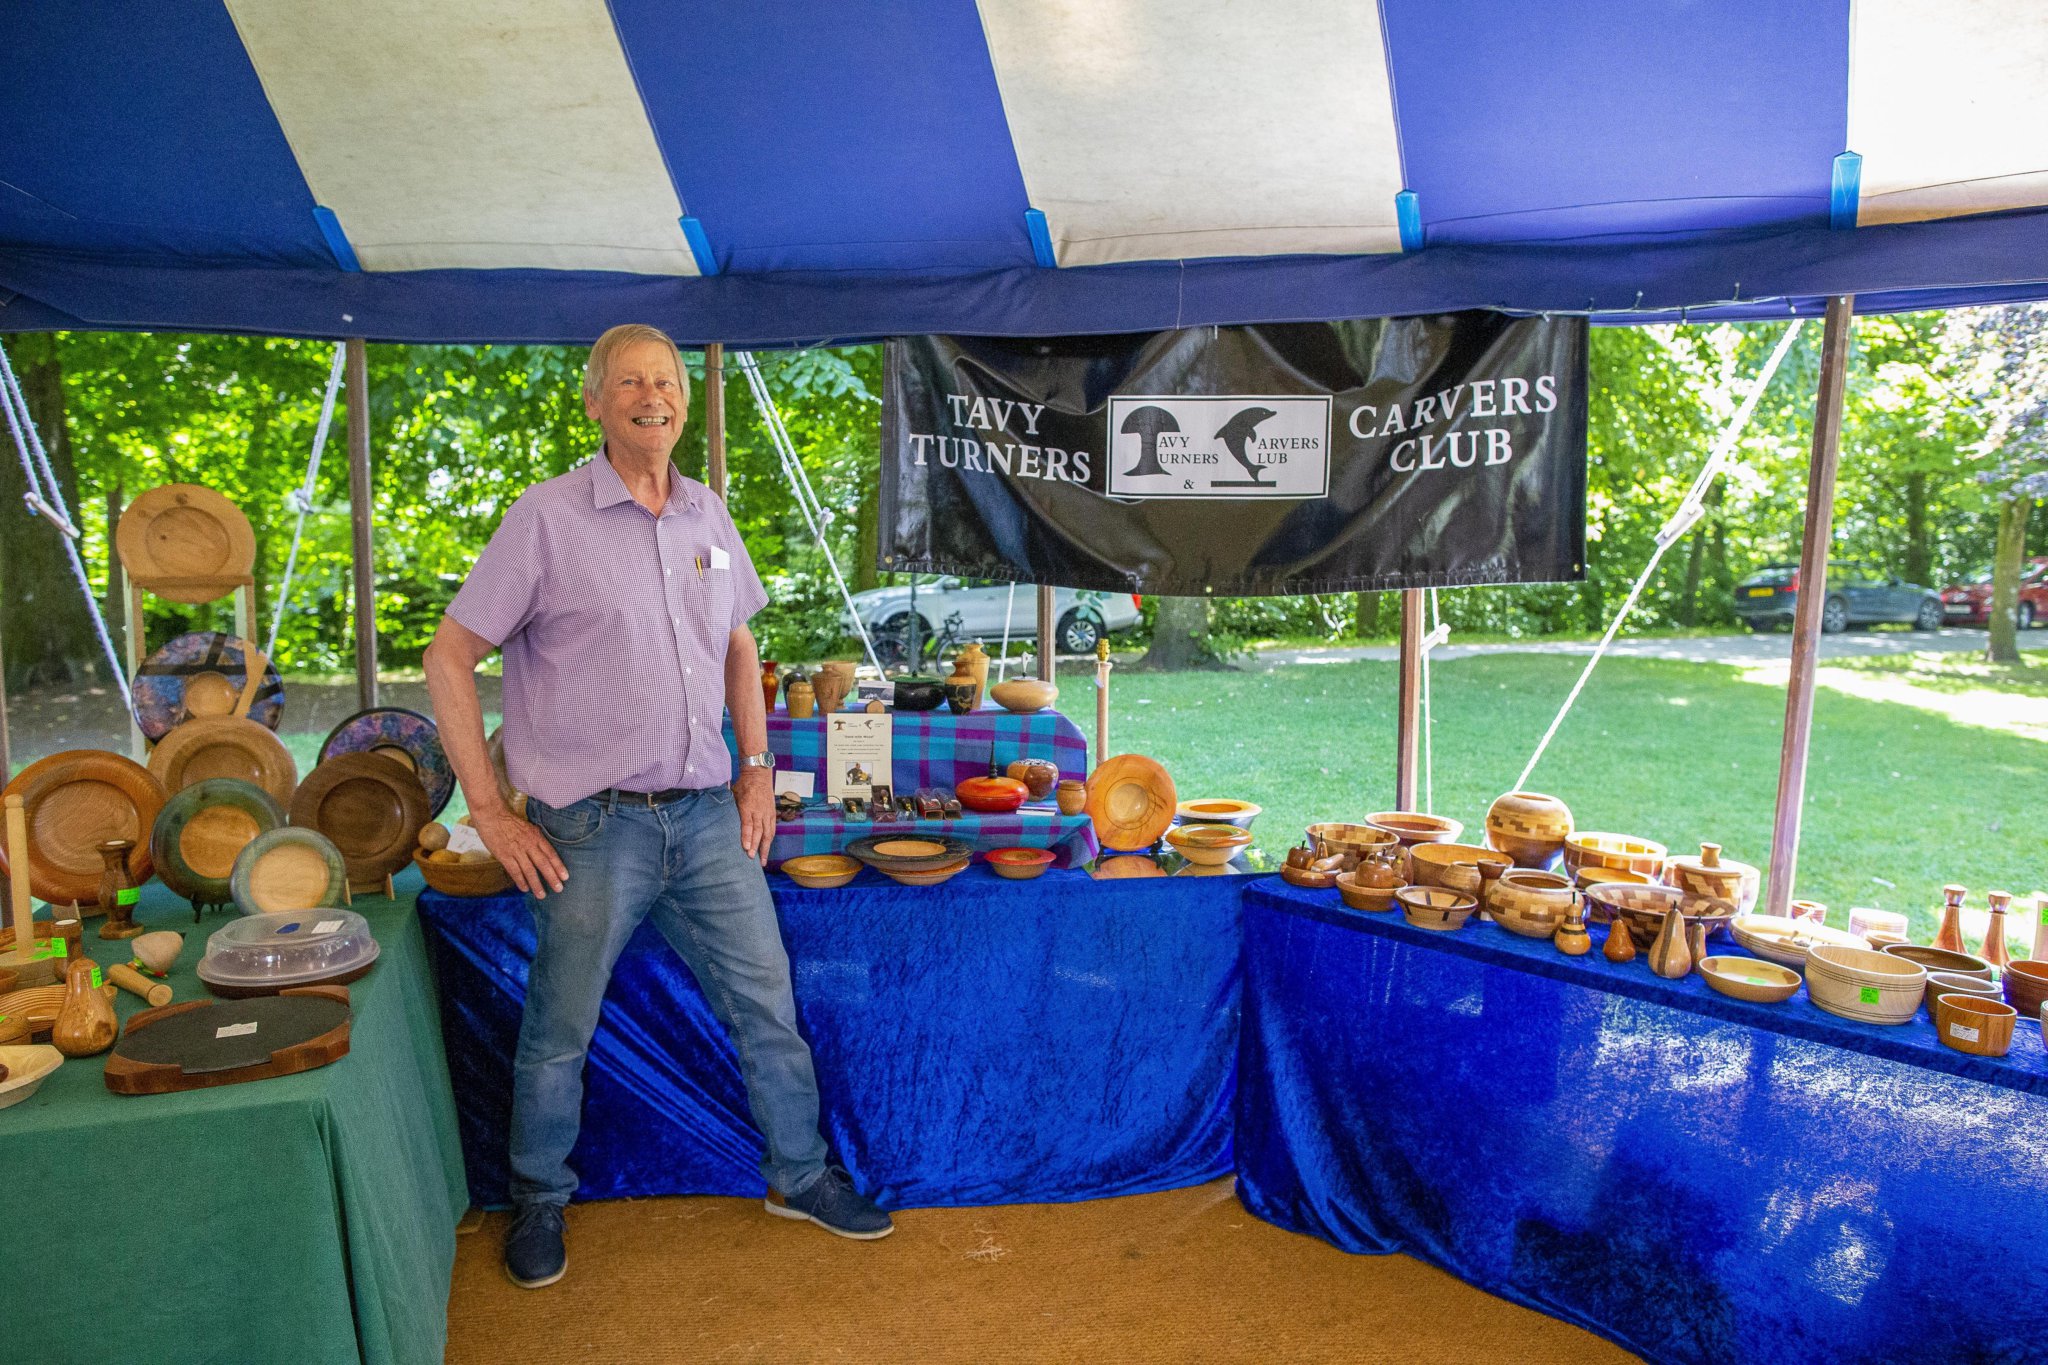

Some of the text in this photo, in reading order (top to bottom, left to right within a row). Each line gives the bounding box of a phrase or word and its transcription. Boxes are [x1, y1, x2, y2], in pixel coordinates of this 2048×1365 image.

[947, 394, 1045, 435] TAVY
[1349, 375, 1558, 439] CARVERS
[909, 433, 1091, 483] TURNERS
[1390, 428, 1513, 472] CLUB
[1183, 479, 1194, 490] &
